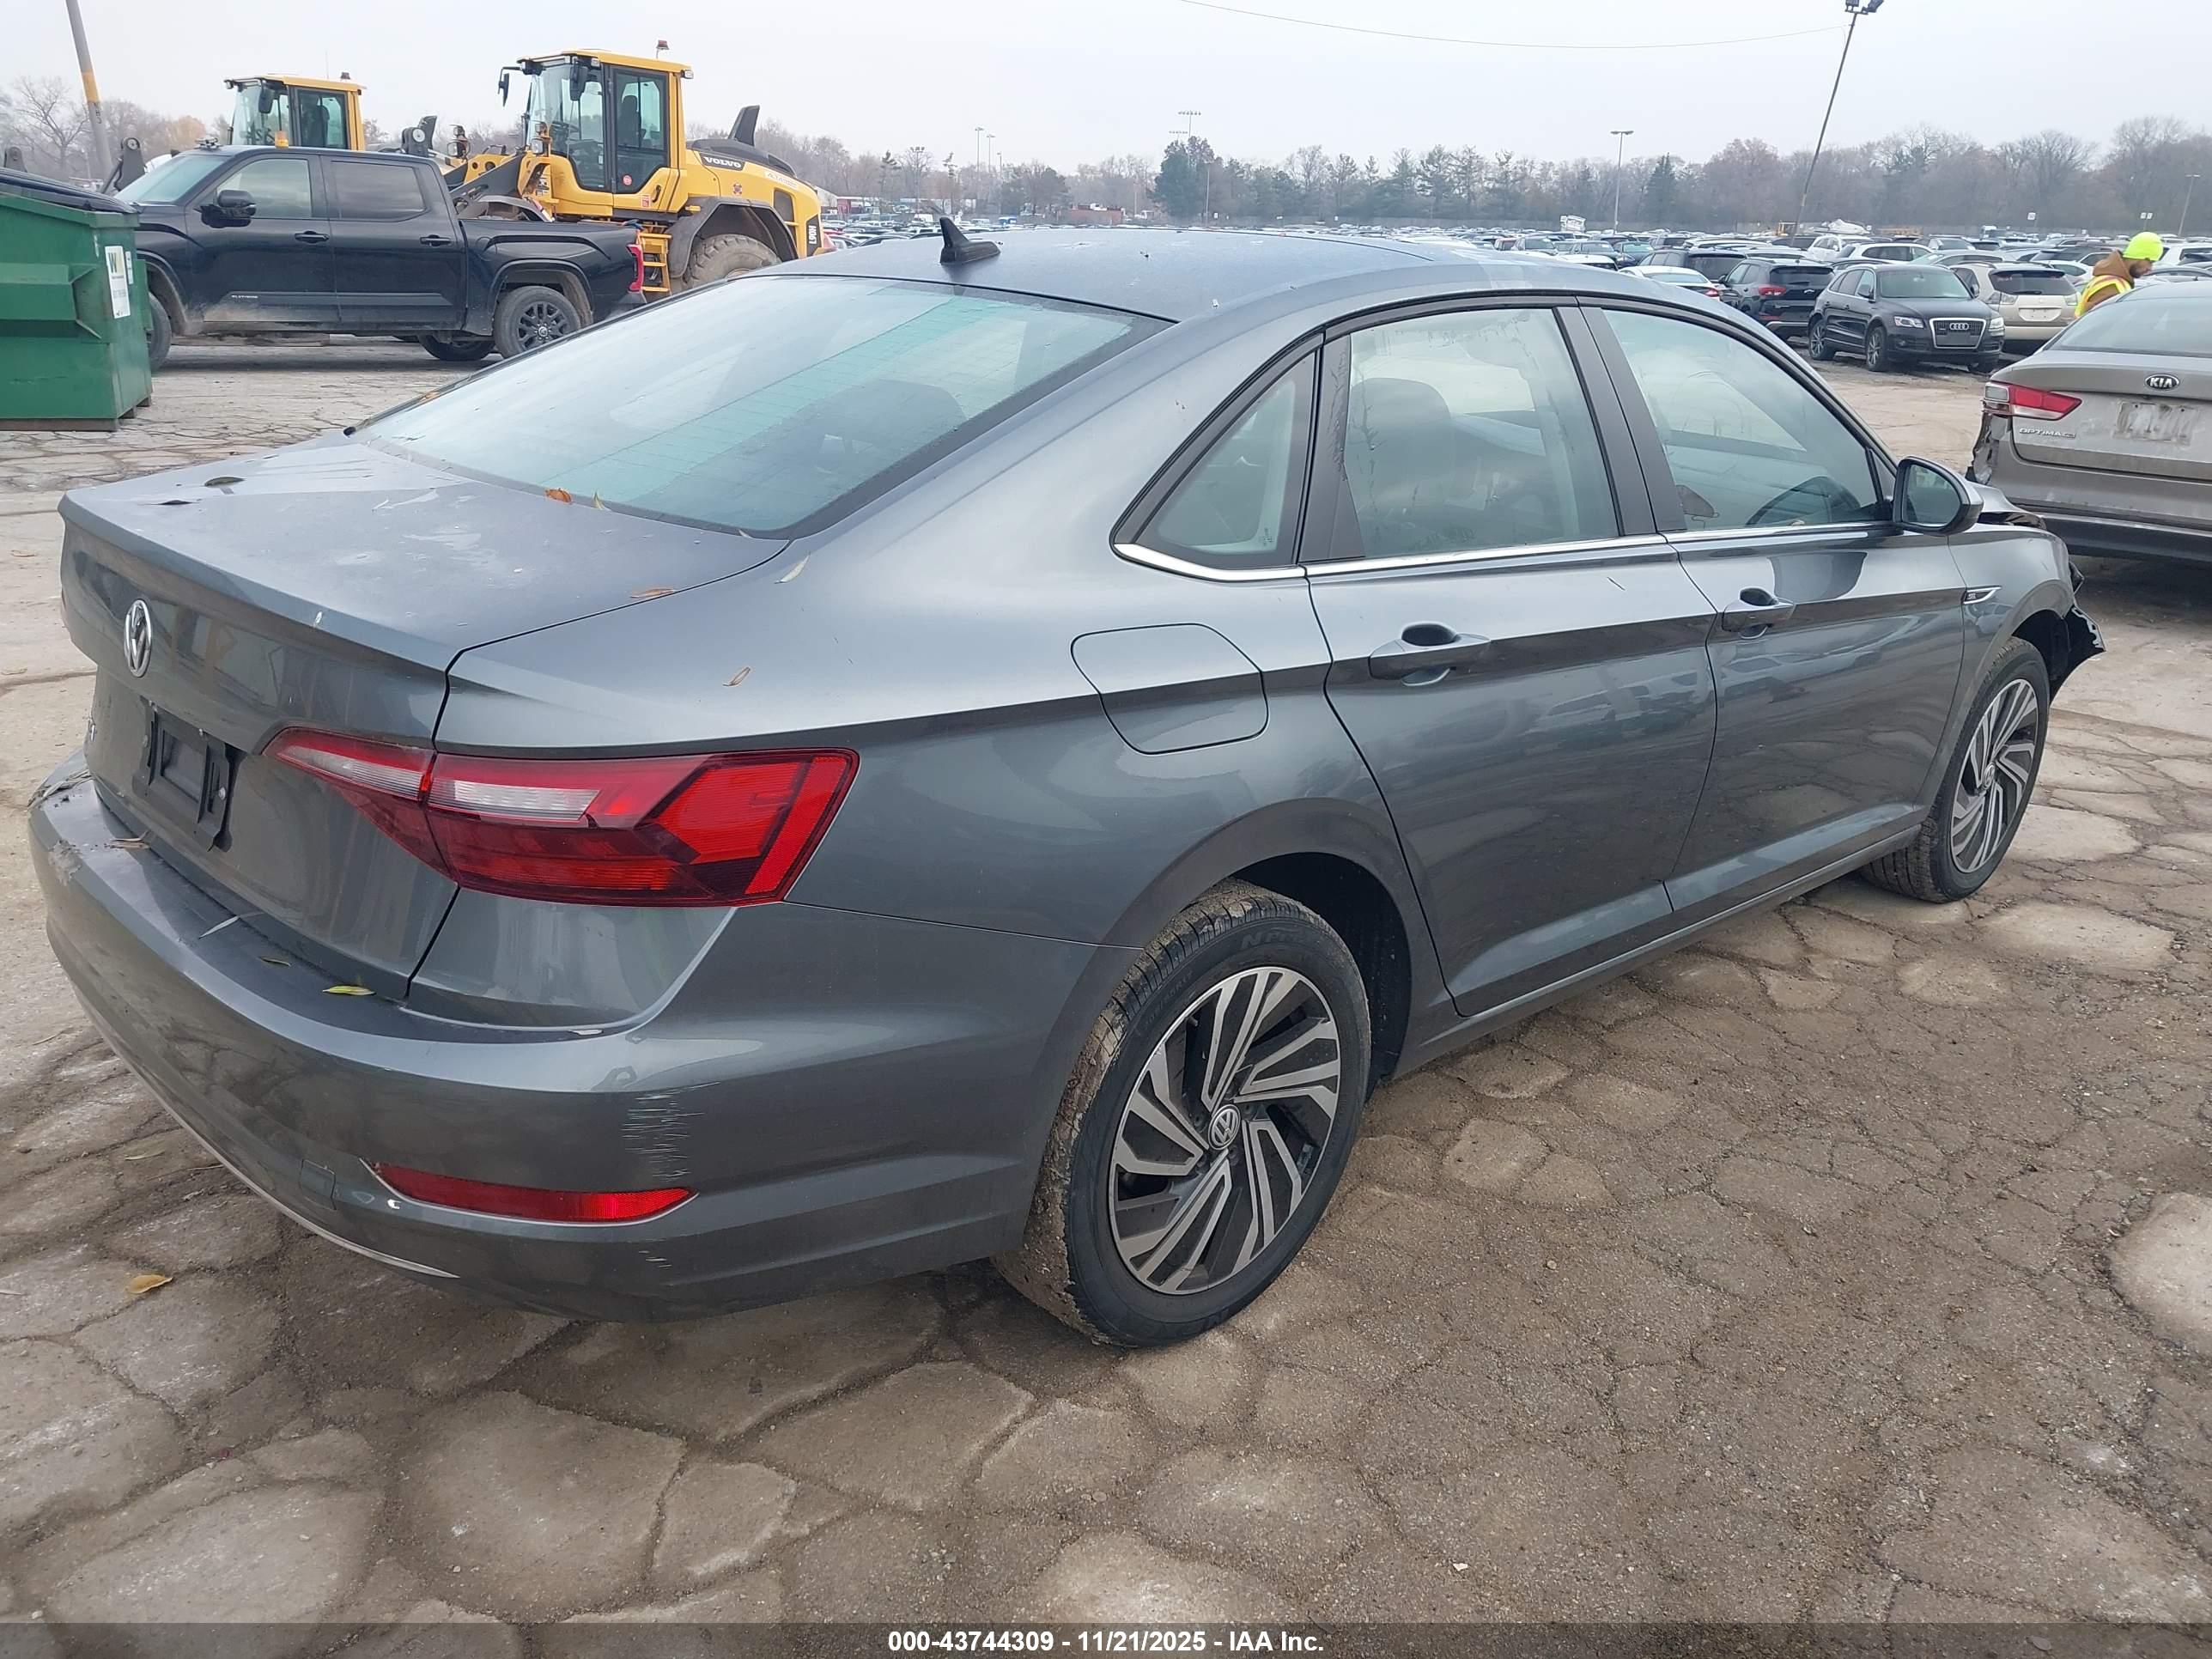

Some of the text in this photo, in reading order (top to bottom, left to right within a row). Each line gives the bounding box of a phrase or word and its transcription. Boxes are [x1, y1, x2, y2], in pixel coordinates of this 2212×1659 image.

[703, 156, 742, 168] VOLVO
[808, 225, 817, 245] L90H
[2149, 377, 2172, 388] KIA
[2019, 428, 2062, 437] OPTIMA
